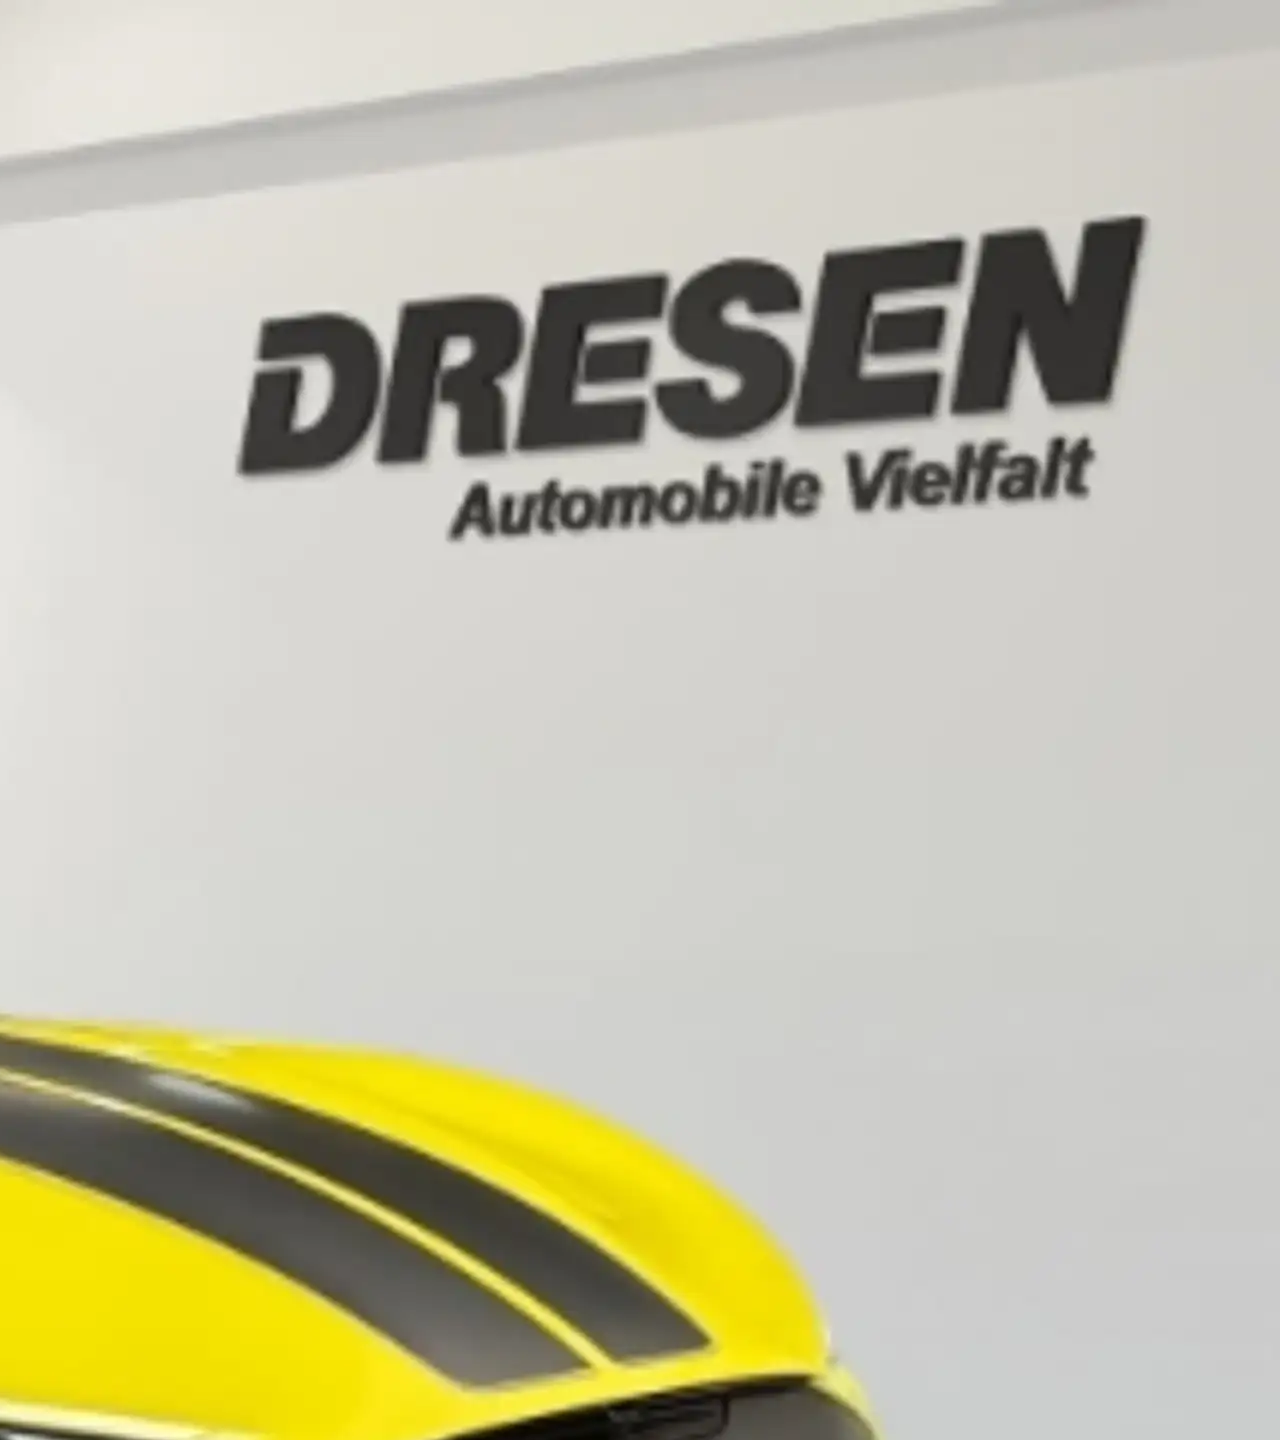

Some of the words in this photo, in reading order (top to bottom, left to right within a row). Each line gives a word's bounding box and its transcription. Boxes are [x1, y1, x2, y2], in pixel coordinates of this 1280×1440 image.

[237, 215, 1146, 477] DRESEN
[448, 458, 822, 541] Automobile
[844, 436, 1096, 512] Vielfalt
